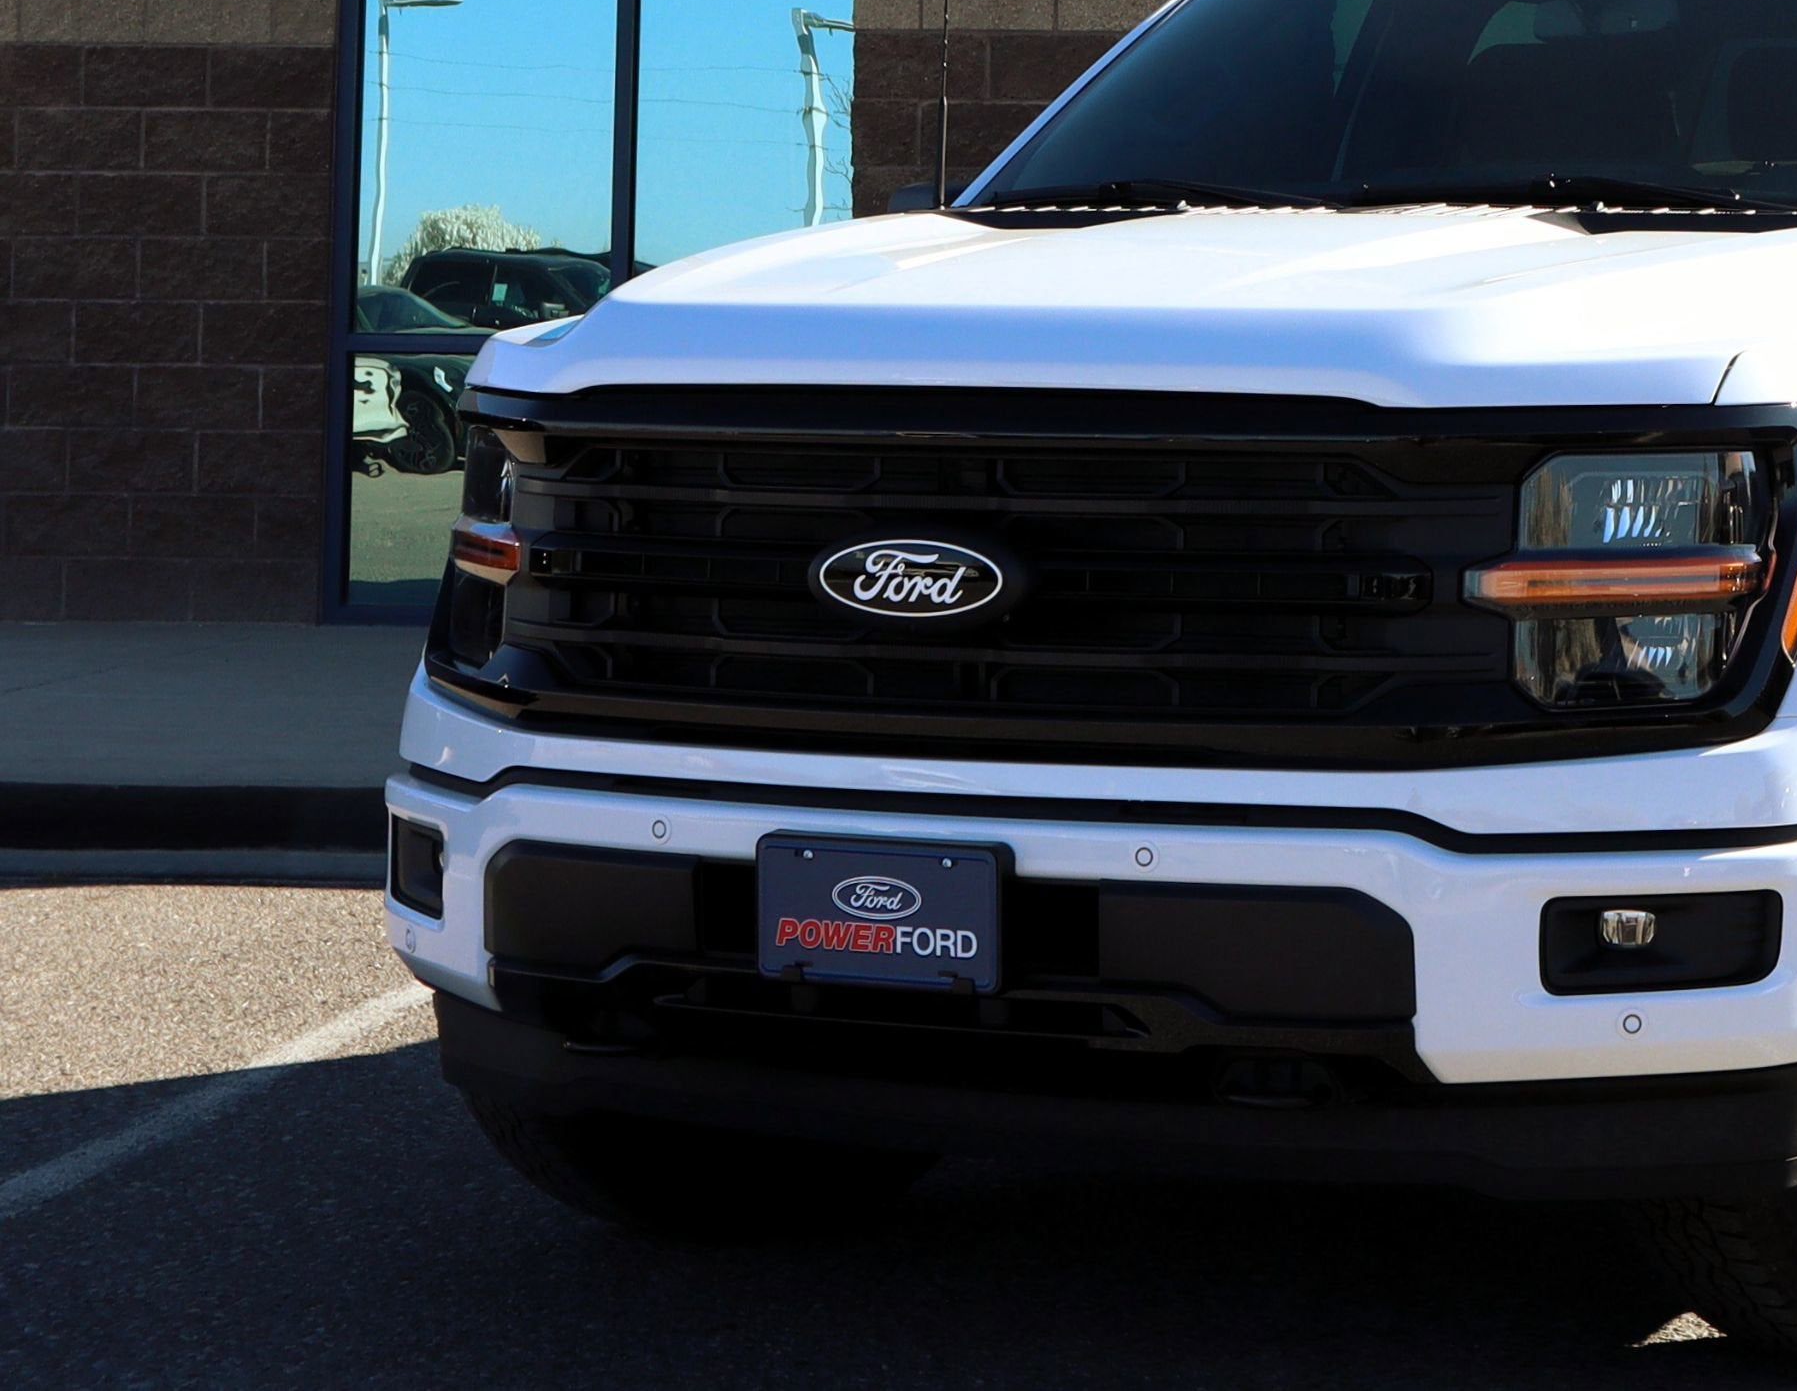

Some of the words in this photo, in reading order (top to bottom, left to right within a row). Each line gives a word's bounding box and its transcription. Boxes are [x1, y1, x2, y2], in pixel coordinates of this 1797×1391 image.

[853, 549, 965, 604] Ford
[850, 883, 902, 911] Ford
[776, 917, 978, 959] POWERFORD
